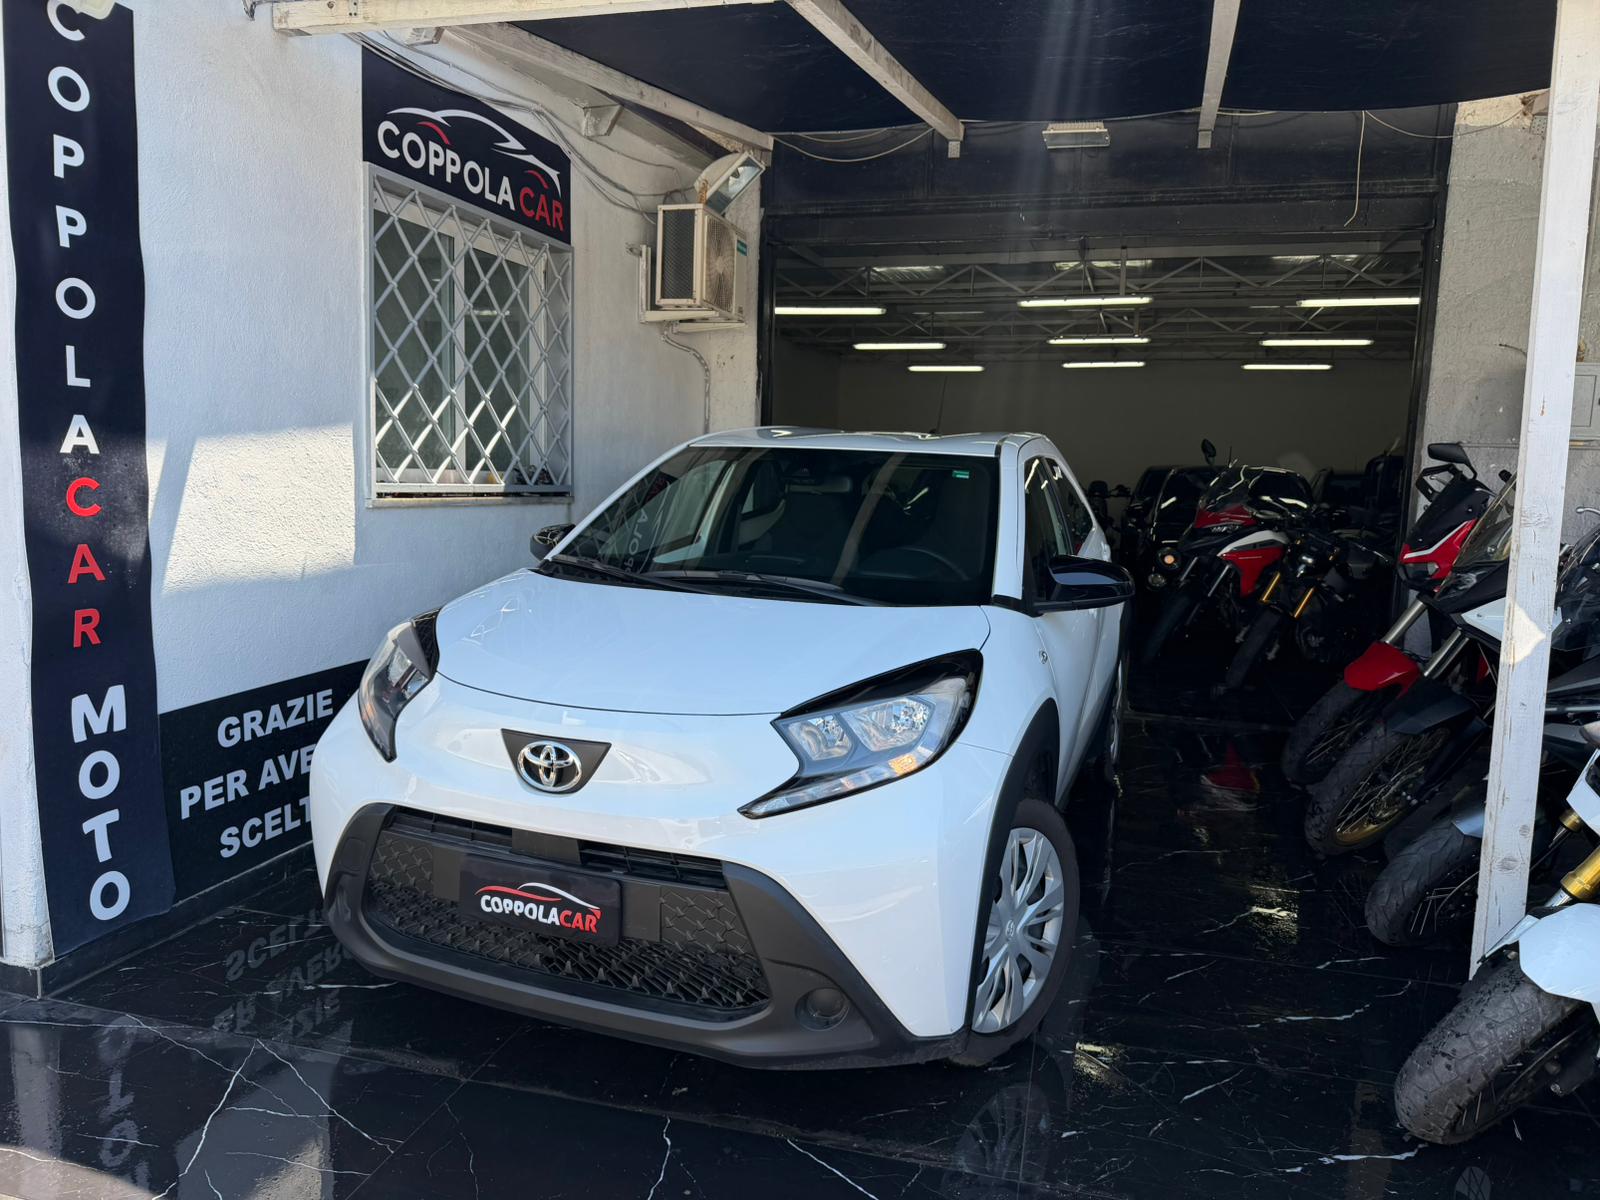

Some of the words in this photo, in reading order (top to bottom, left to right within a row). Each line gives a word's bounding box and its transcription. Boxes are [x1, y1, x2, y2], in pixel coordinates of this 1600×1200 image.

[377, 120, 515, 211] COPPOLA
[519, 187, 565, 231] CAR
[66, 477, 106, 648] CAR
[217, 688, 334, 748] GRAZIE
[71, 684, 130, 921] MOTO
[180, 768, 249, 820] PER
